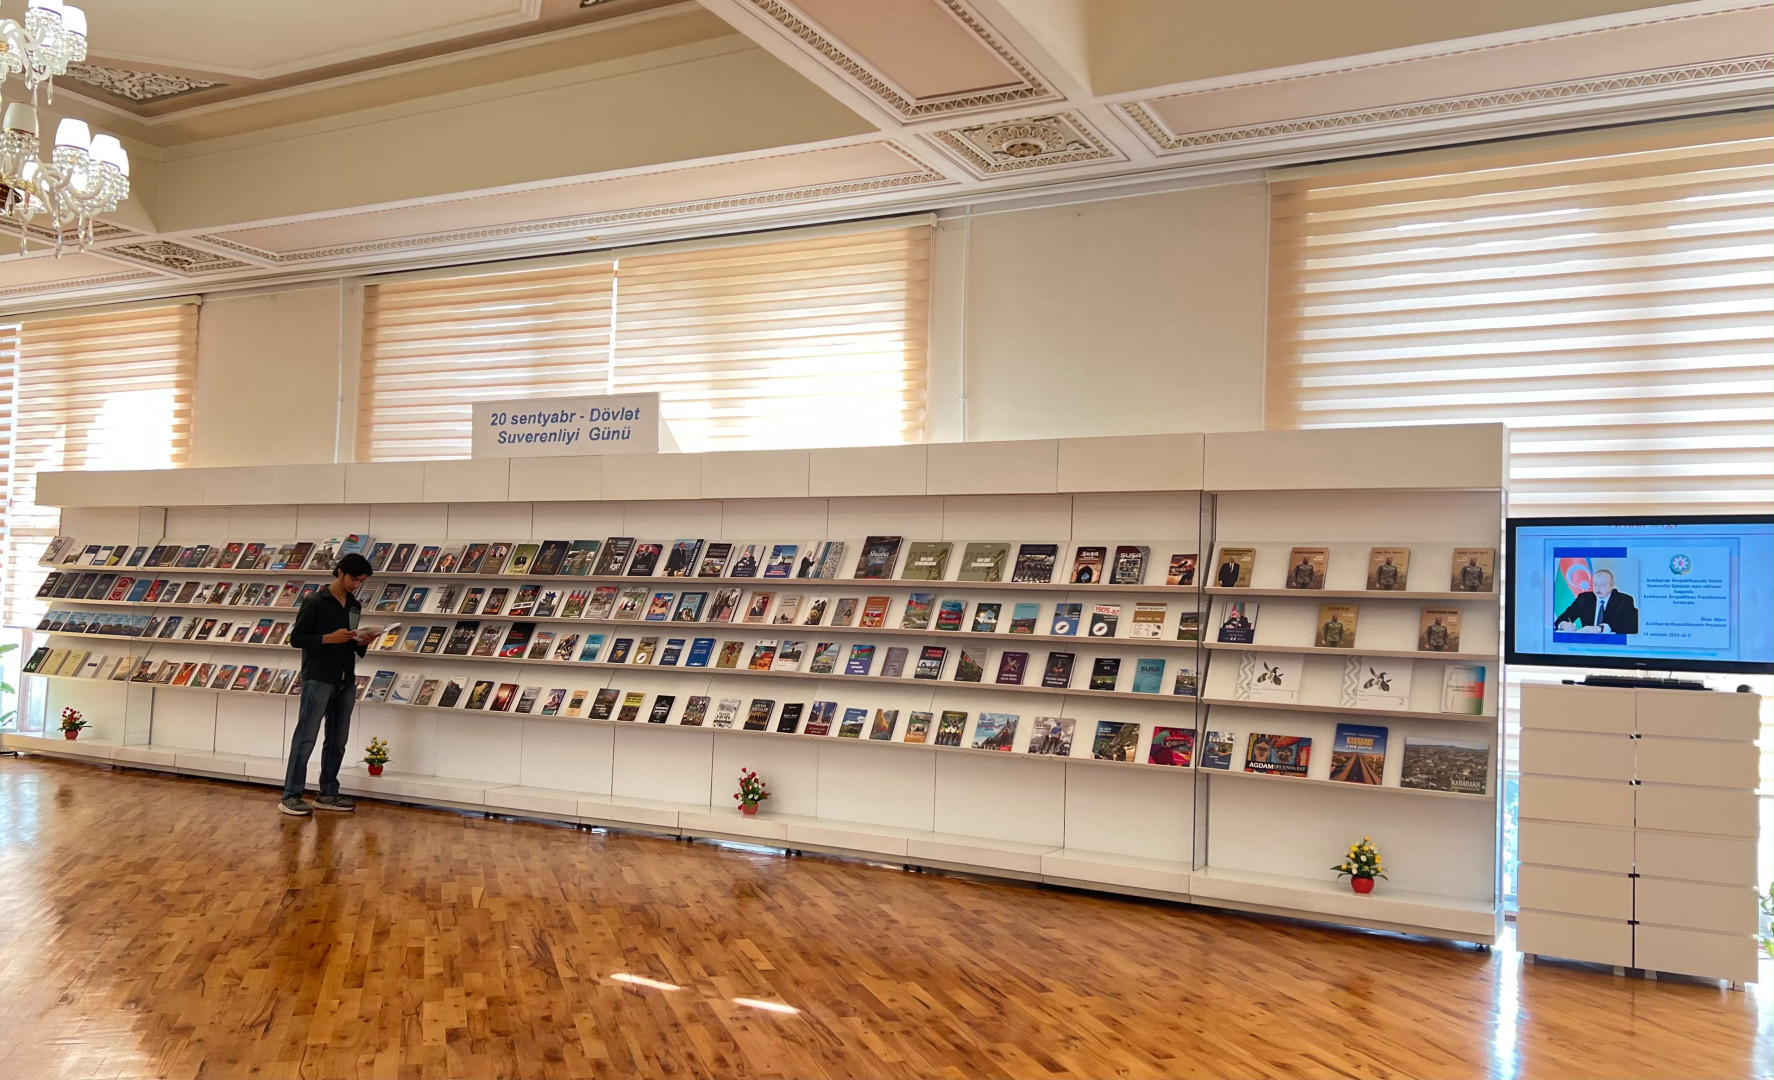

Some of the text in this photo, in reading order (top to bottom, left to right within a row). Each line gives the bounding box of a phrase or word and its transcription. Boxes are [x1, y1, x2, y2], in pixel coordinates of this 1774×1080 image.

[490, 412, 507, 426] 20
[510, 410, 576, 427] sentyabr
[589, 407, 640, 422] Dövlət
[498, 426, 631, 445] Suverenliyi Günü
[1451, 780, 1481, 788] KARABAKH
